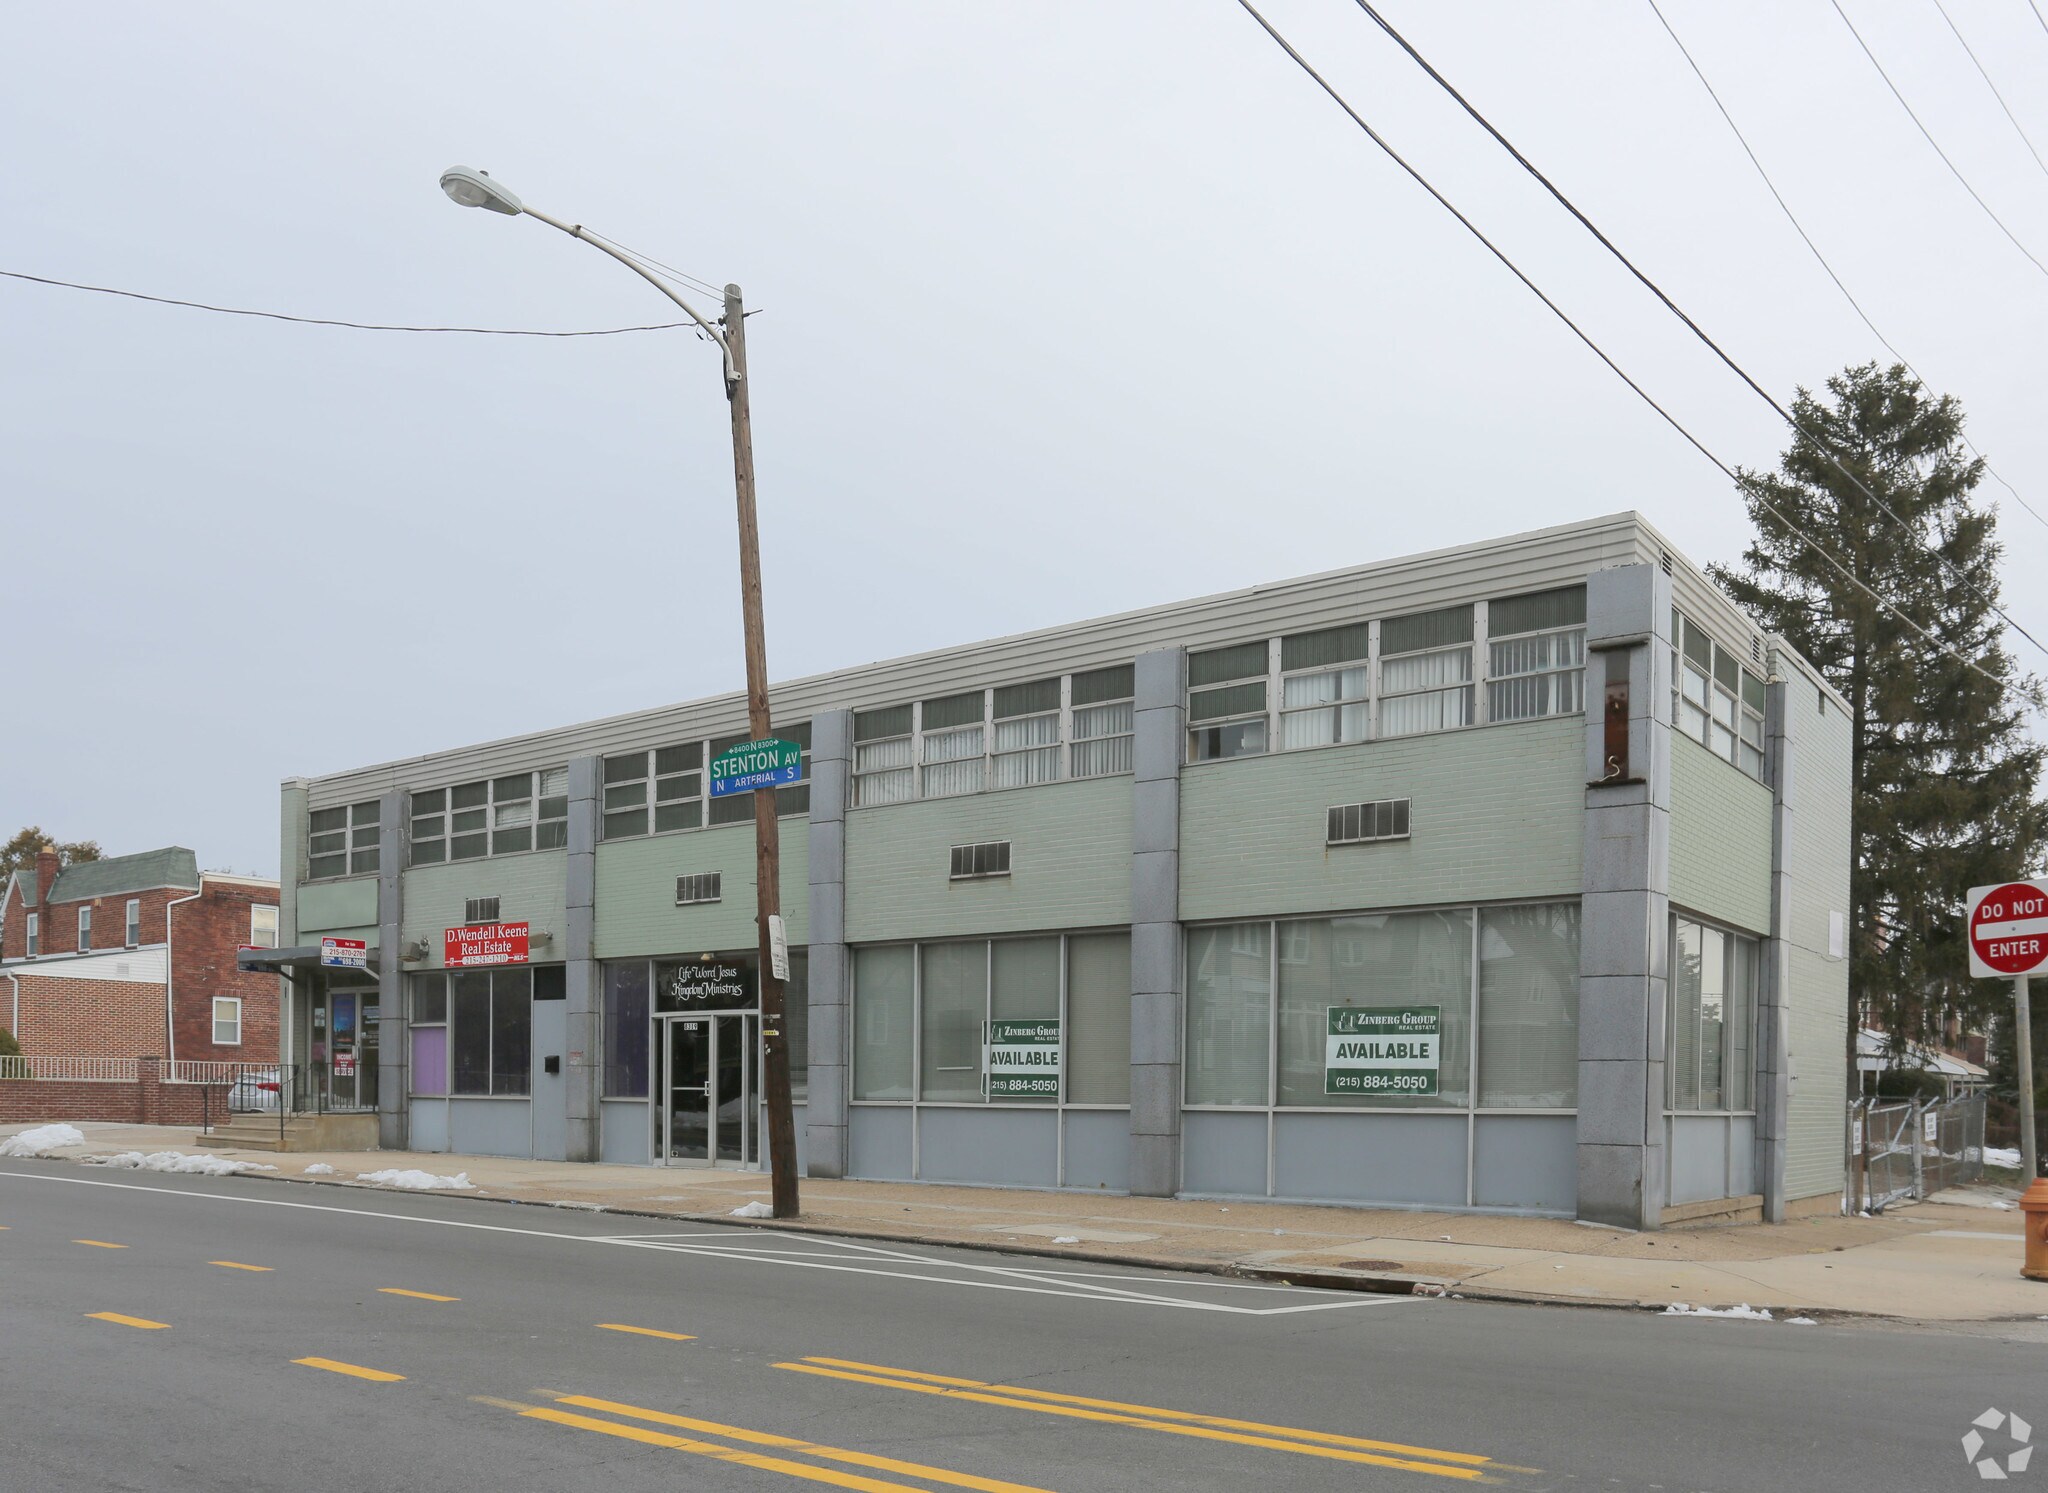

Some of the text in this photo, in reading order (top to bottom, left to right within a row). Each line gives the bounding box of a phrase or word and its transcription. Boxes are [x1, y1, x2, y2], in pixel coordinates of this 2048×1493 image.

[734, 740, 774, 754] 8400 N 8300
[713, 750, 798, 778] STENTON AV
[716, 767, 794, 792] N ARTERIAL S
[1982, 898, 2044, 919] DO NOT
[497, 925, 527, 939] Keene
[461, 941, 512, 955] Real Estate
[1989, 940, 2040, 958] ENTER
[678, 965, 737, 983] Life Word Jesus
[671, 982, 743, 1000] Kingdom Ministries
[1357, 1012, 1437, 1025] ZINBERG GROUP
[1004, 1025, 1036, 1036] ZINBERG
[990, 1051, 1059, 1065] AVAILABLE
[1336, 1043, 1429, 1059] AVAILABLE
[1009, 1080, 1058, 1091] 884-5050
[1336, 1076, 1428, 1089] (215) 884-5050
